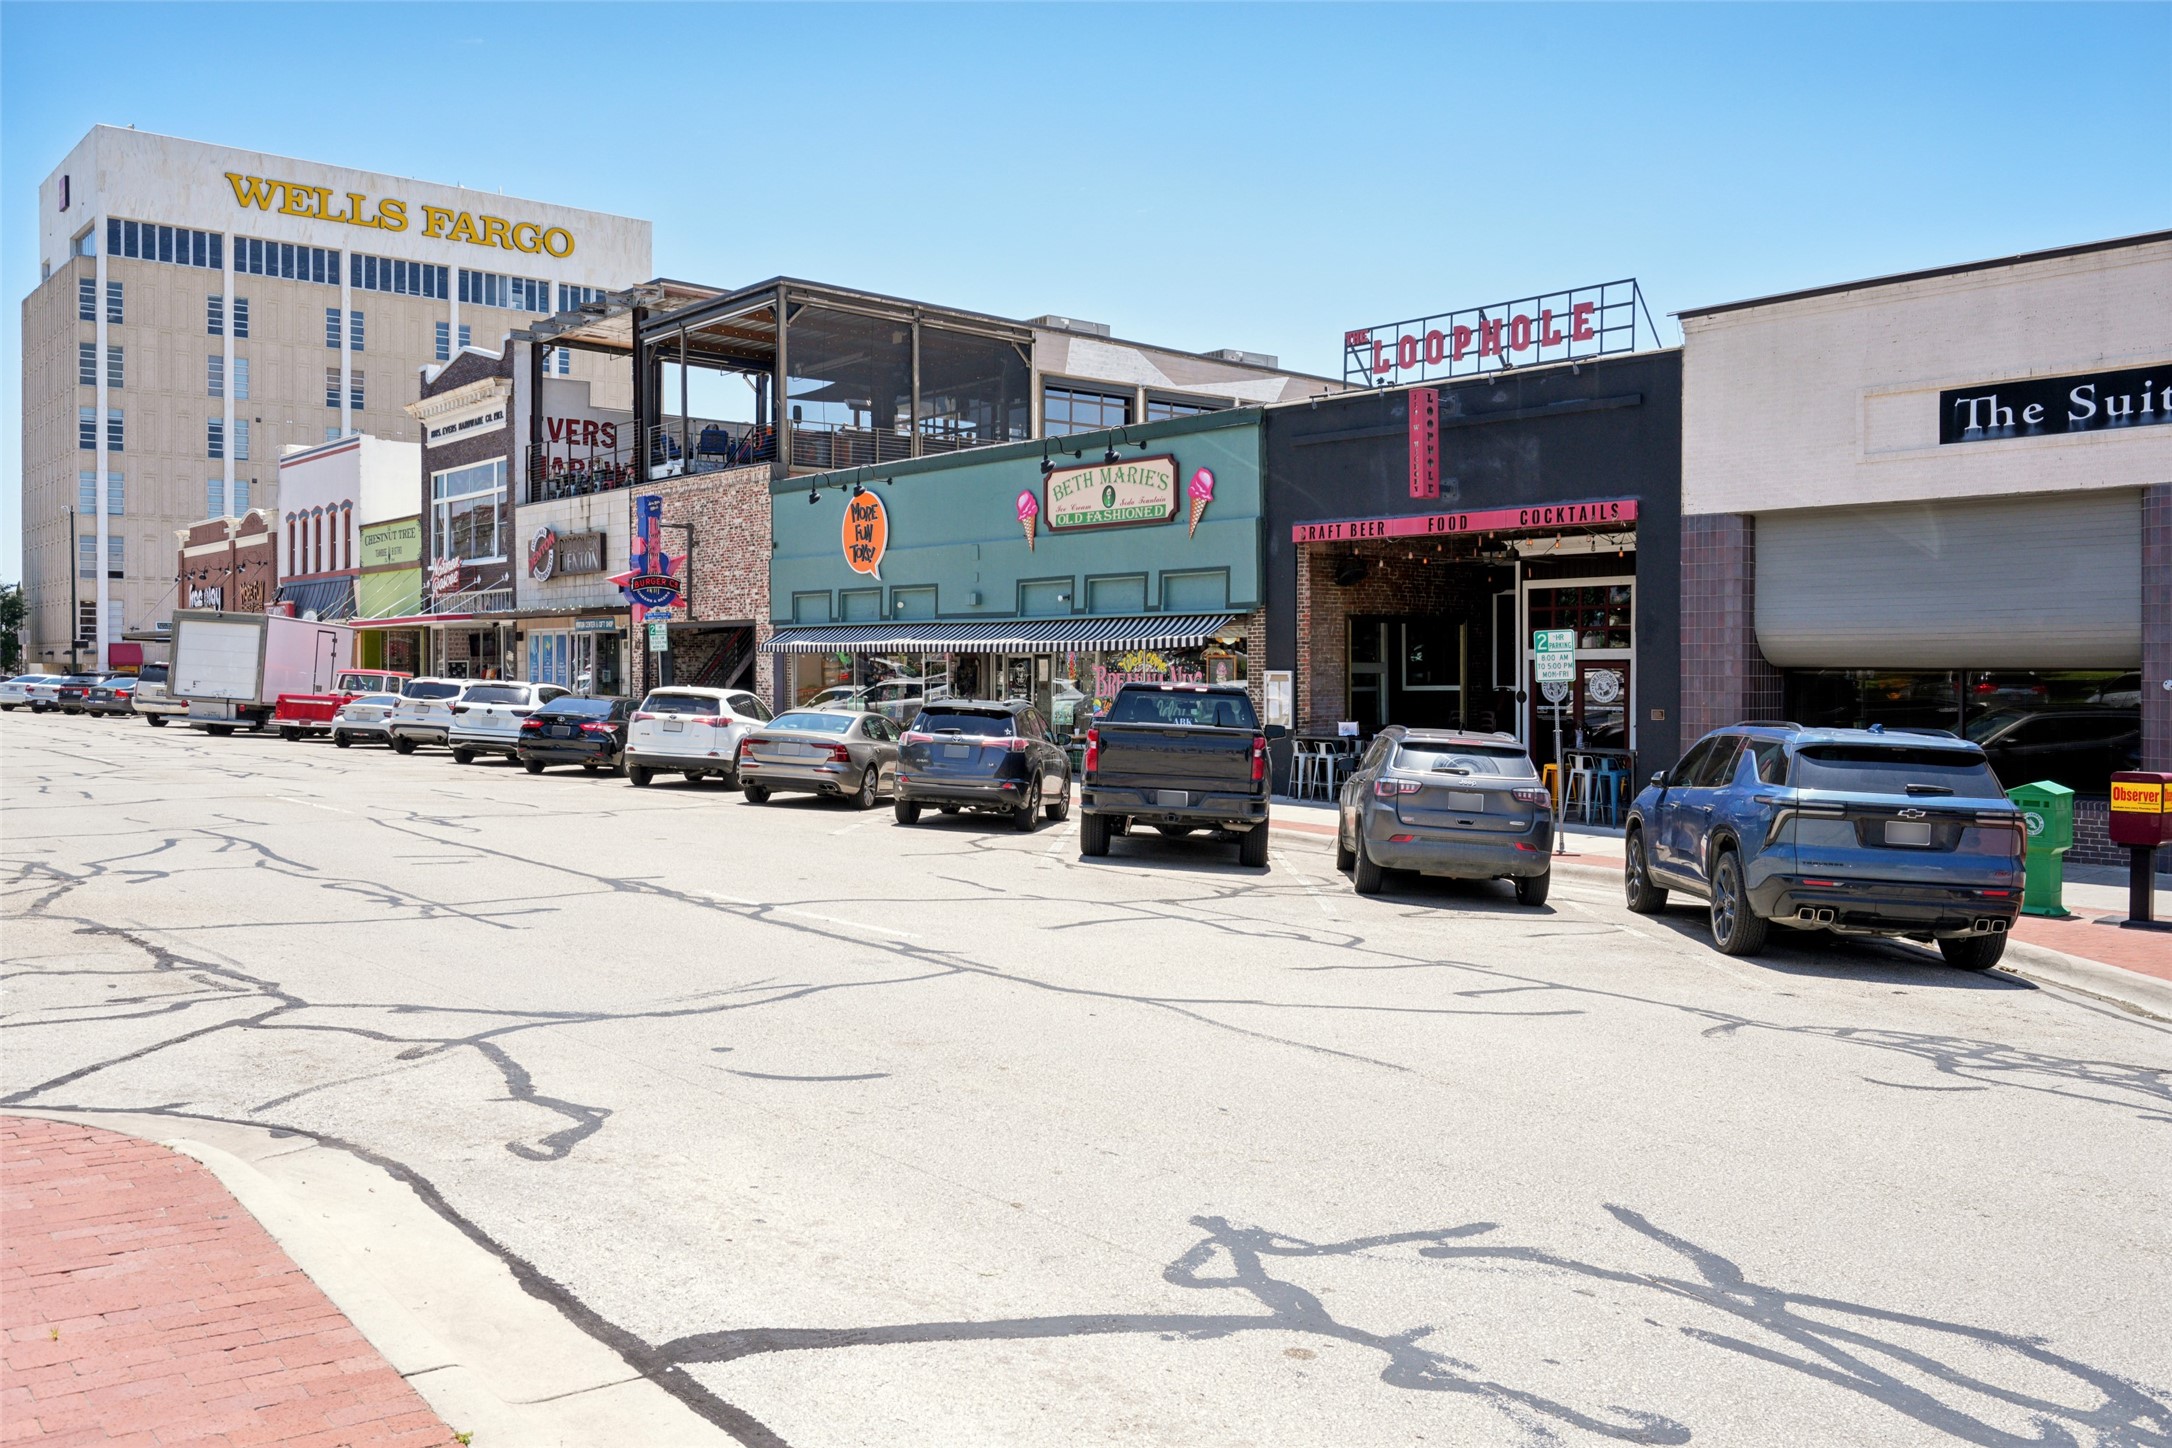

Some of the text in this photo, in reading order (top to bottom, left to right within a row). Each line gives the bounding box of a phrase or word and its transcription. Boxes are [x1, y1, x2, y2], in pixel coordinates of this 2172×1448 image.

[225, 172, 576, 259] WELLS FARGO
[1344, 328, 1370, 346] THE
[1372, 301, 1594, 375] LOOPHOLE
[1954, 394, 2044, 430] The
[442, 424, 457, 435] EVERS
[530, 415, 616, 448] VERS
[1426, 393, 1434, 493] LOOPHOLE
[1052, 466, 1170, 502] BETH MARIE'S
[850, 502, 878, 523] MORE
[1057, 505, 1164, 525] OLD FASHIONED
[1520, 503, 1619, 525] COCKTAILS
[855, 523, 873, 543] FUN
[1299, 521, 1385, 541] CRAFT BEER
[1428, 515, 1468, 532] FOOD
[365, 531, 397, 546] CHESTNUT
[398, 527, 416, 539] TREE
[528, 530, 555, 572] DENTON
[849, 543, 876, 563] TOYS!
[634, 577, 667, 588] BURGER
[650, 624, 656, 635] 2
[1537, 633, 1548, 650] 2
[1549, 642, 1572, 650] PARKING
[1542, 671, 1569, 679] MON-FRI
[1458, 779, 1477, 787] Jeep
[2112, 785, 2160, 803] Observer
